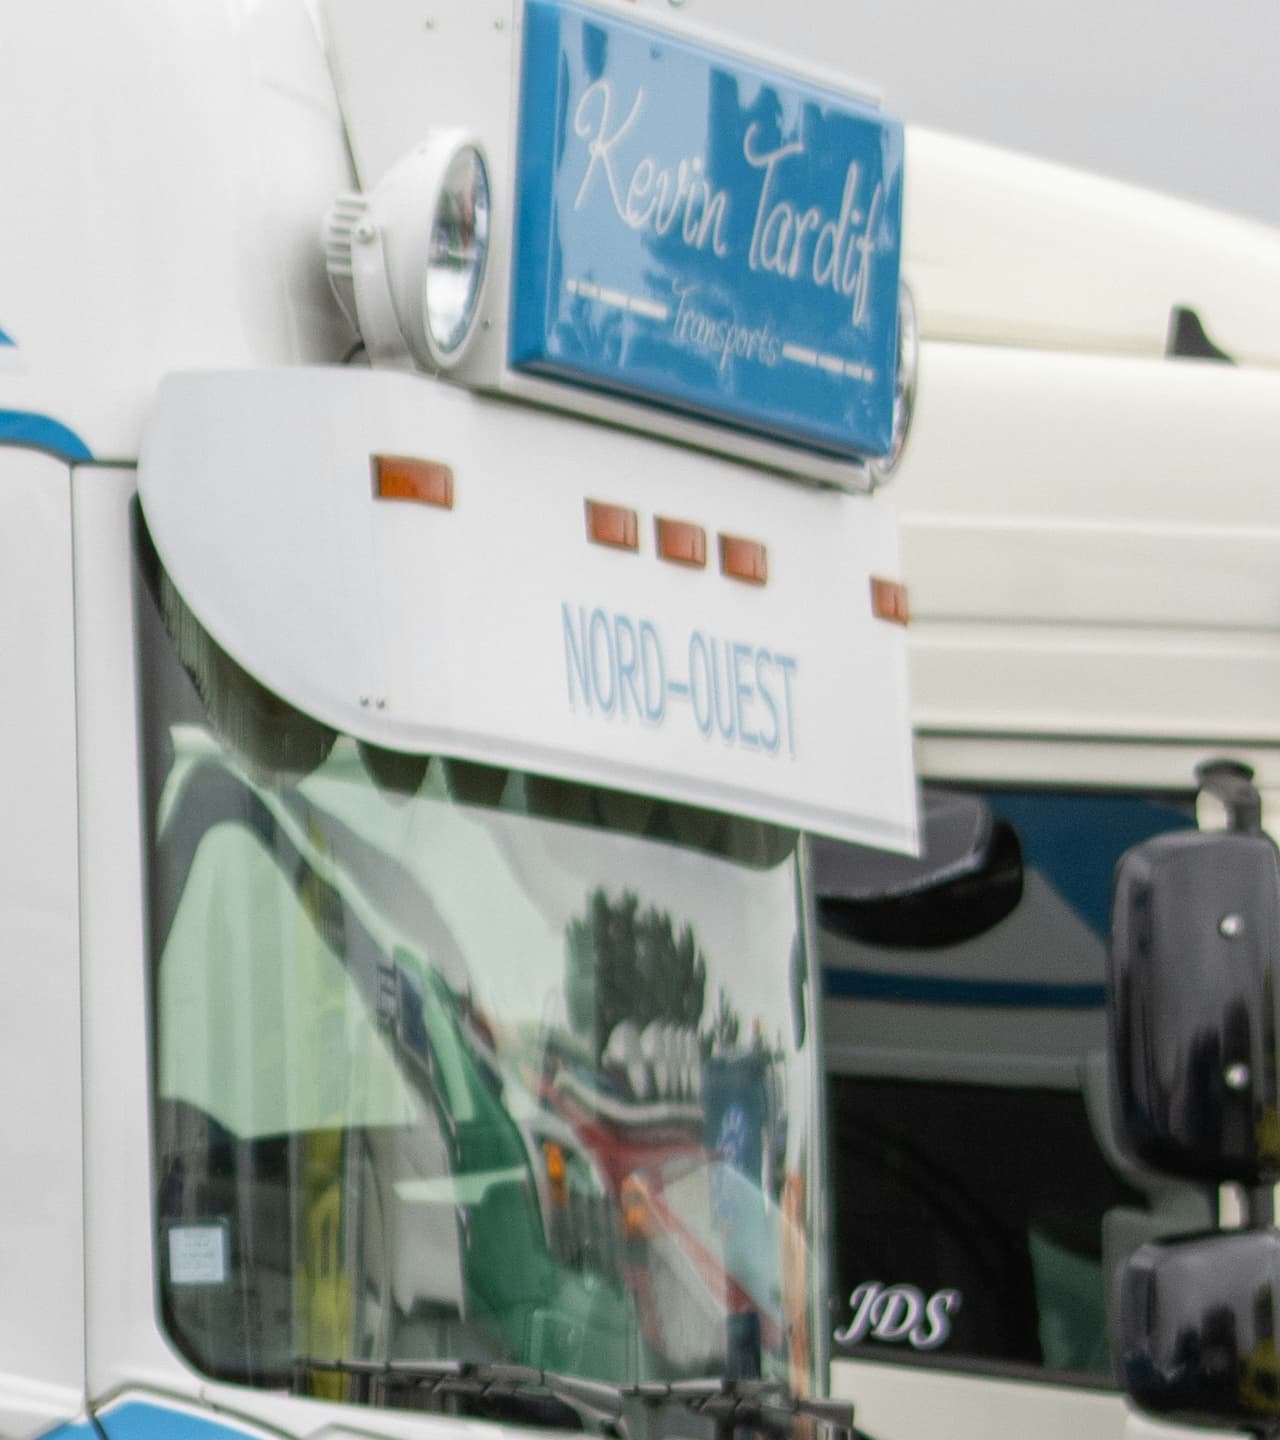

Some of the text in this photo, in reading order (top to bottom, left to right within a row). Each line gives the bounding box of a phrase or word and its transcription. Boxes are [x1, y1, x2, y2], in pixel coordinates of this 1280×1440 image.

[573, 78, 884, 327] Kevin Tardif
[671, 275, 780, 371] Transports
[561, 600, 798, 760] NORD-OUEST
[834, 1280, 961, 1347] JDS
